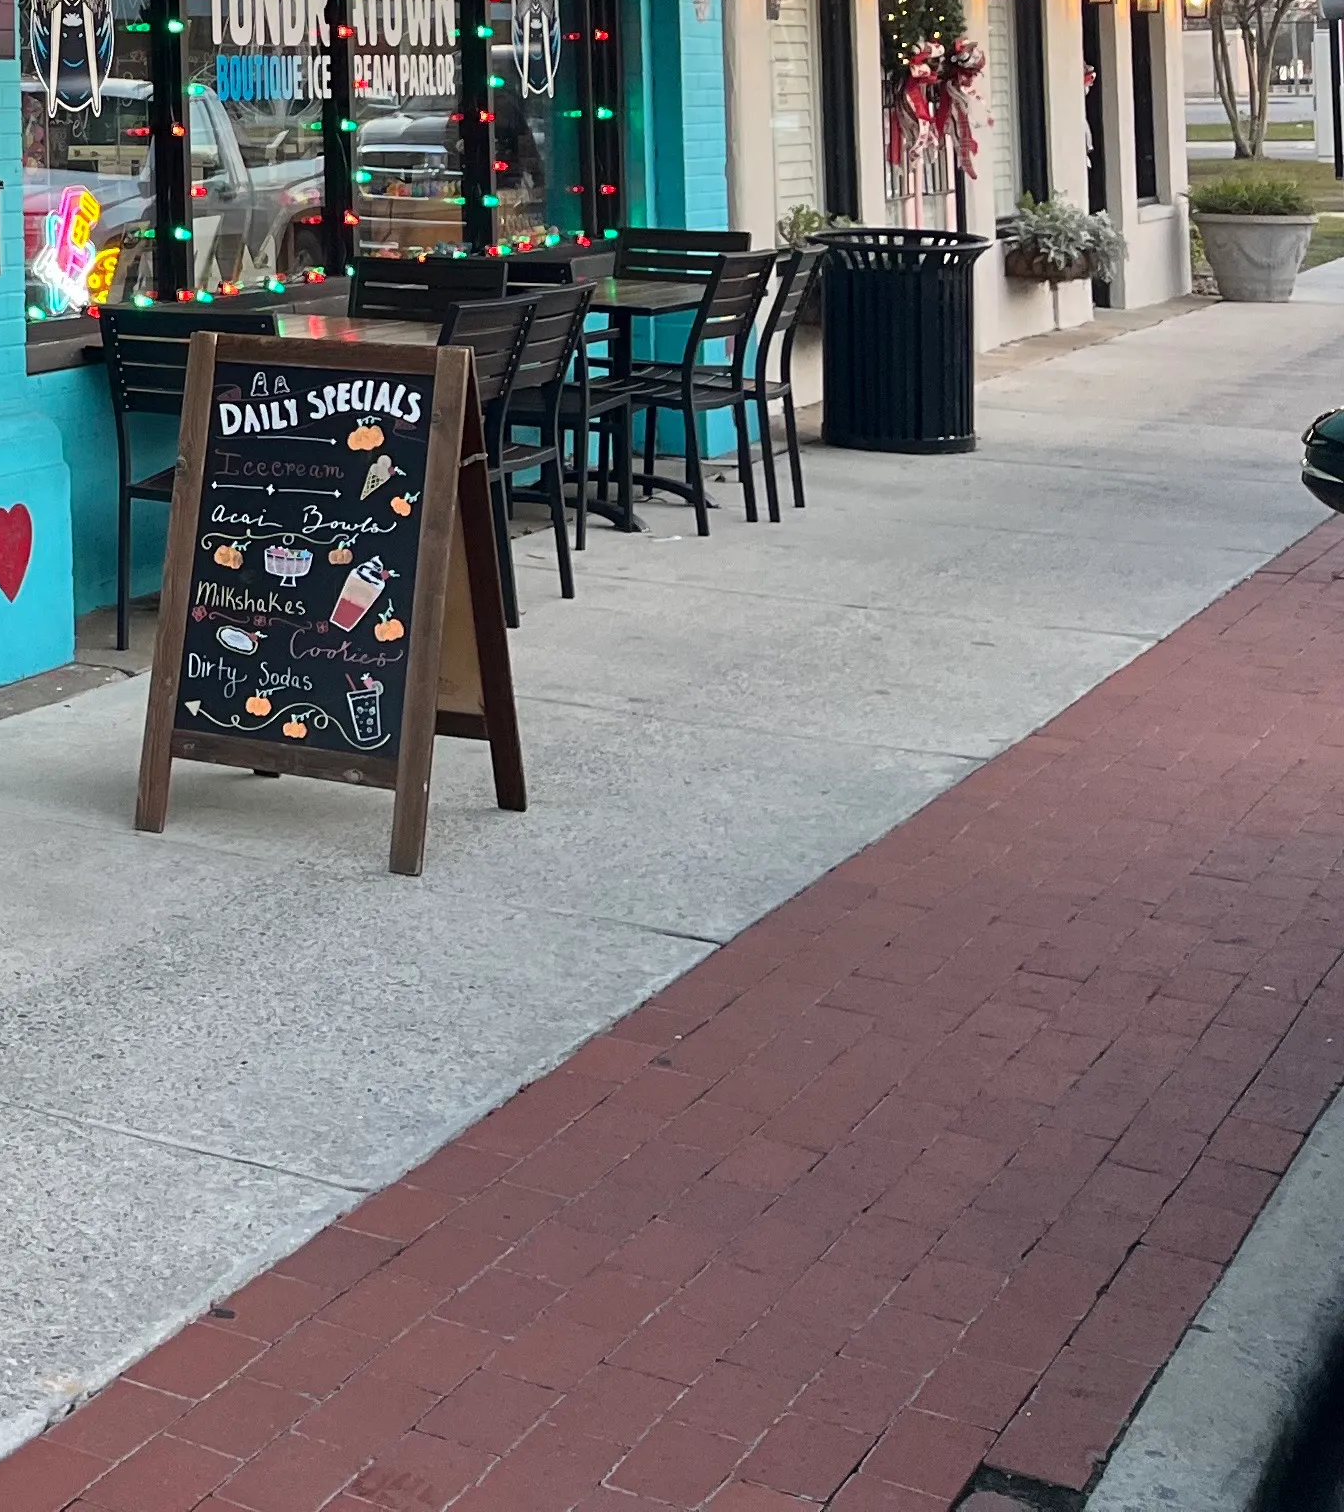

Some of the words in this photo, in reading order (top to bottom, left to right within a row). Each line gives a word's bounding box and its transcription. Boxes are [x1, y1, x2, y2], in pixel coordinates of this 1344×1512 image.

[216, 54, 304, 102] BOUTIQUE
[308, 54, 332, 99] ICE
[353, 54, 396, 97] REAM
[399, 54, 456, 97] PARLOR
[219, 399, 299, 435] DAILY
[309, 380, 421, 423] SPECIALS
[215, 449, 344, 479] Icecream
[302, 504, 397, 534] Bowls
[289, 628, 404, 668] Cookies
[188, 652, 248, 698] Dirty
[259, 662, 313, 691] Sodas
